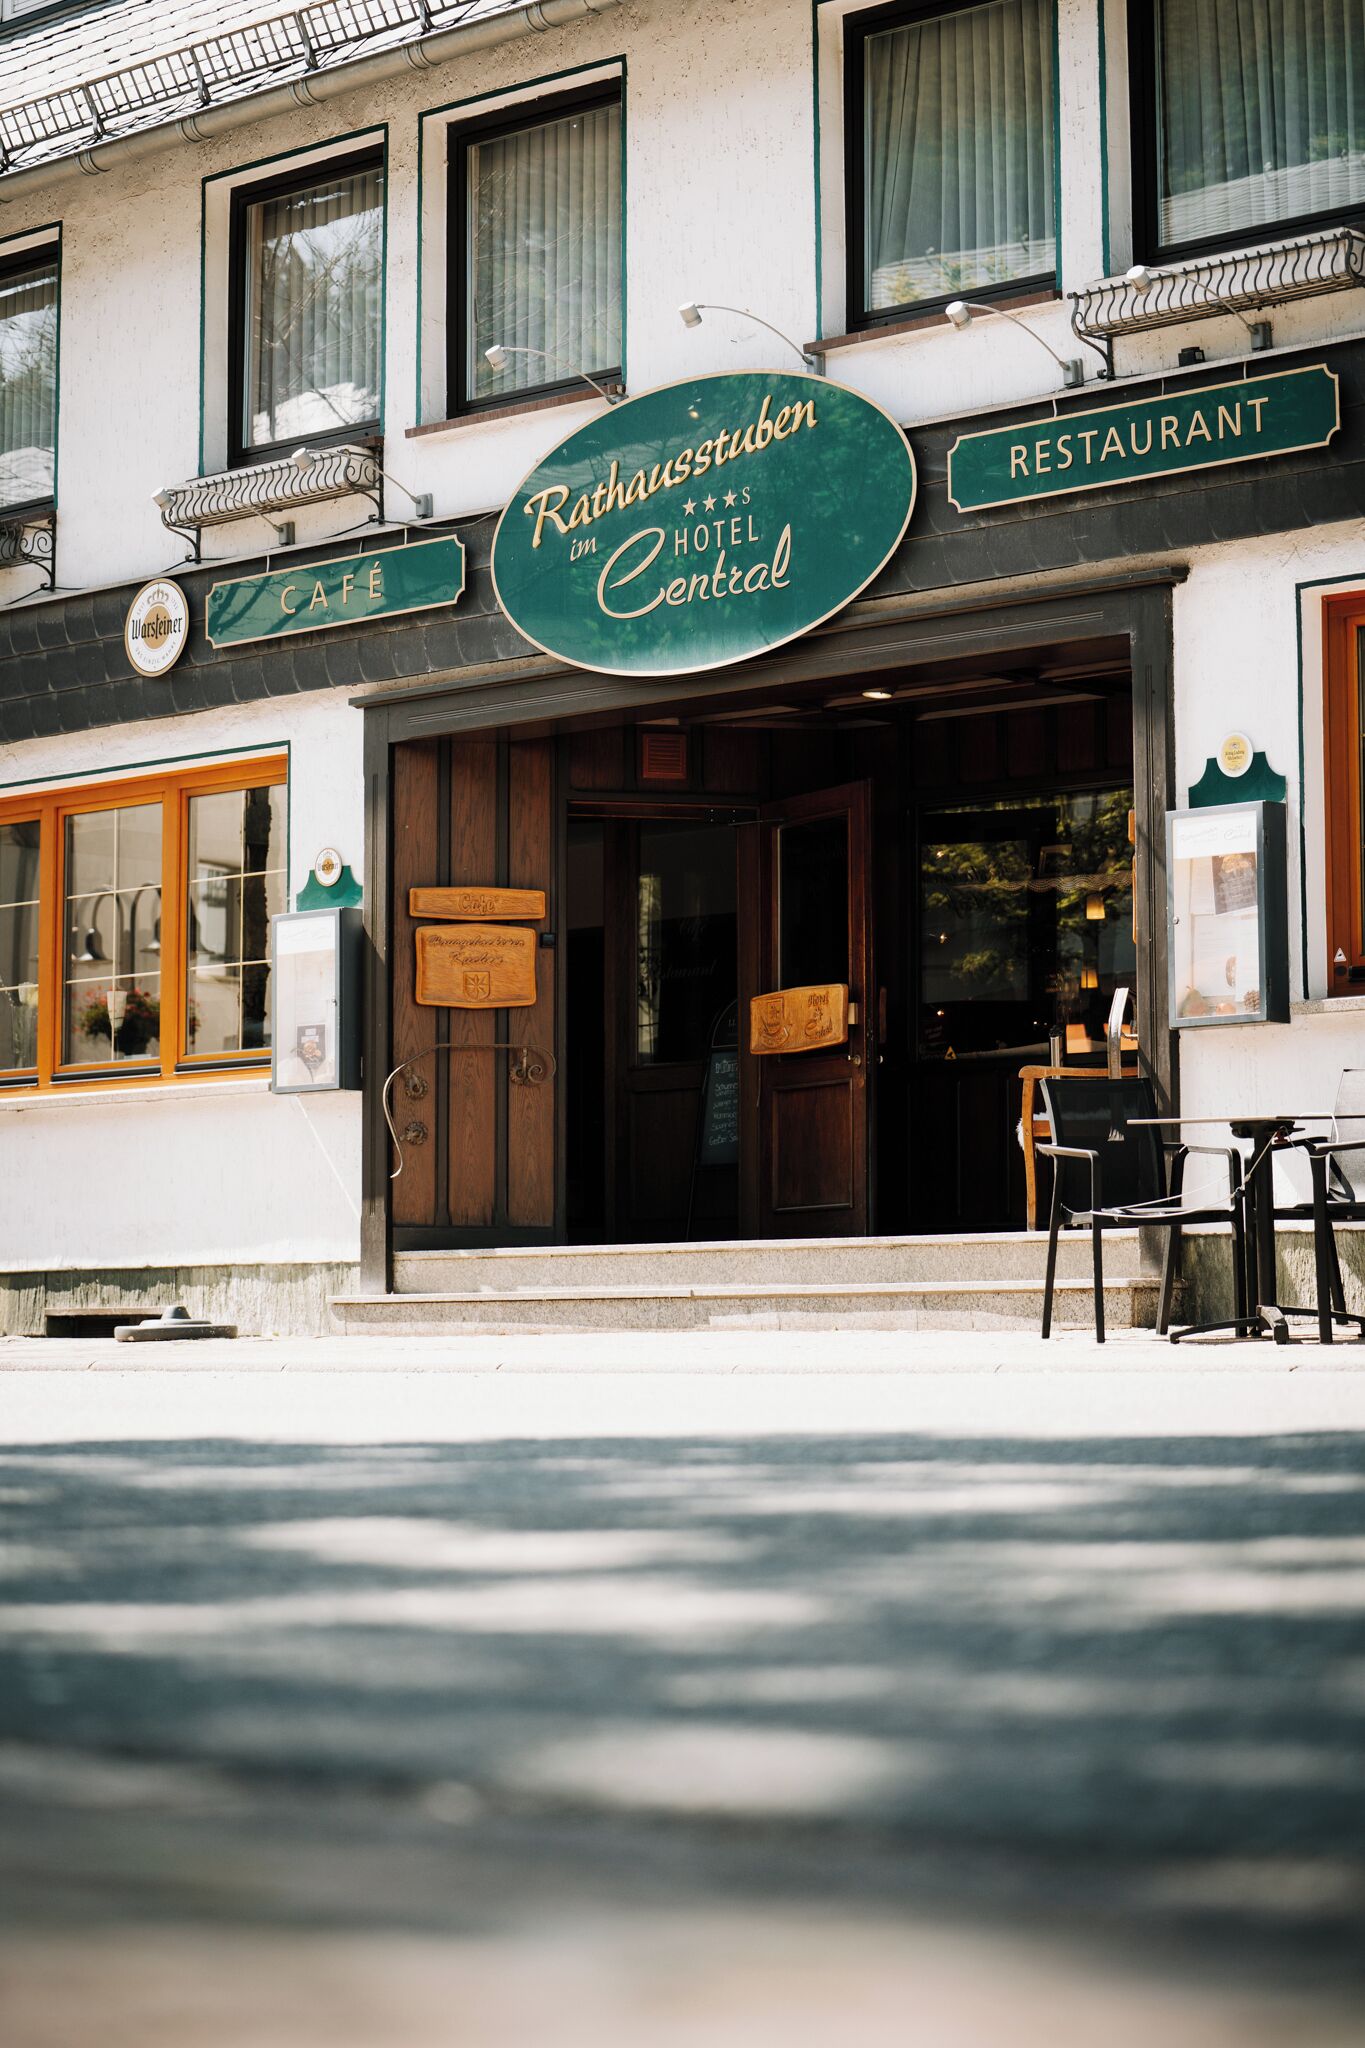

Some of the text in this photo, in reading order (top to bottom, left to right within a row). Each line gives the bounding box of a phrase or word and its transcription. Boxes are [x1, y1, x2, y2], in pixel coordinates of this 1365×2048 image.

[1010, 397, 1269, 479] RESTAURANT
[523, 394, 818, 549] Rathausstuben
[569, 537, 597, 563] im
[674, 515, 760, 556] HOTEL
[281, 561, 382, 614] CAFÉ
[597, 523, 792, 620] Central
[131, 613, 183, 640] Warsteiner
